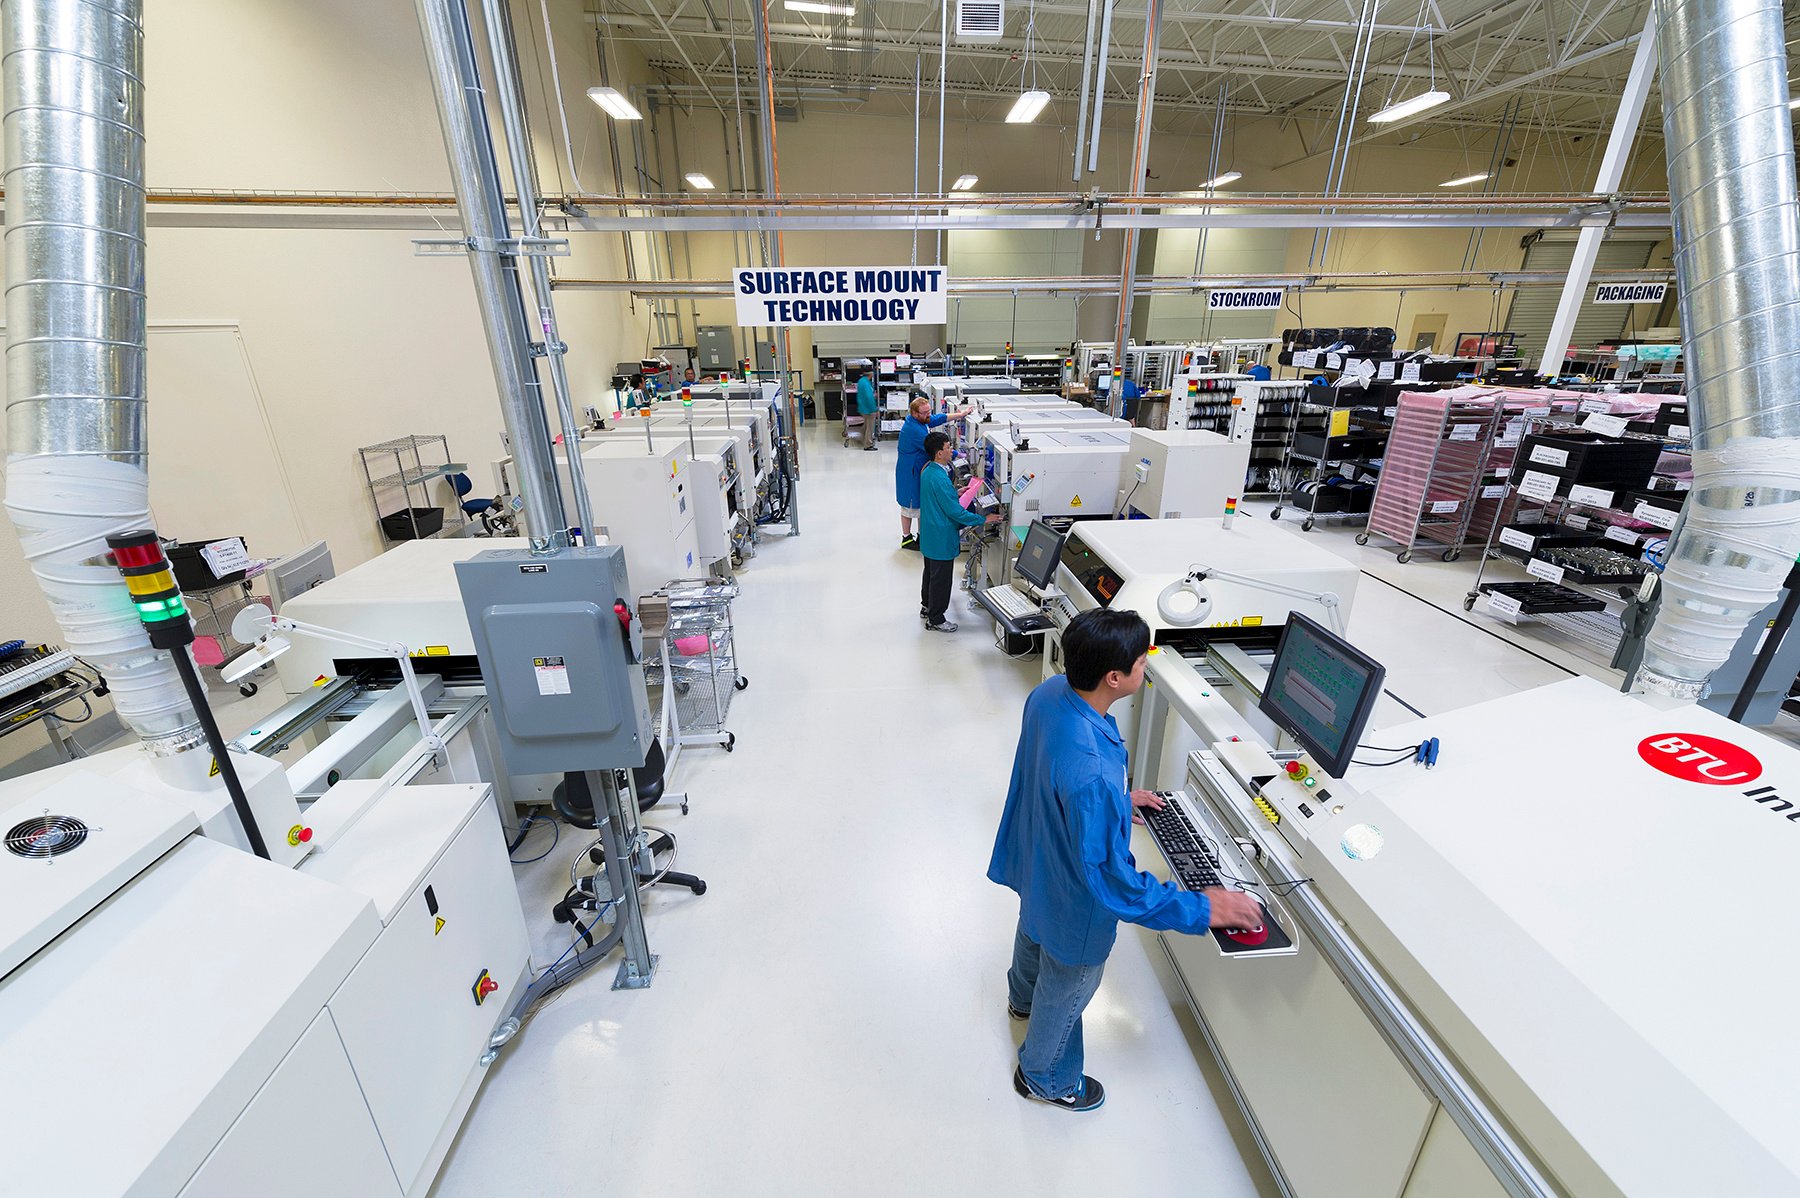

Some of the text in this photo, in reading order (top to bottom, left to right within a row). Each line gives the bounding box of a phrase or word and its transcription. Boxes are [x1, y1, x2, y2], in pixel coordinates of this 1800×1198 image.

[739, 270, 941, 294] SURFACE MOUNT
[1596, 285, 1664, 301] PACKAGING
[764, 298, 920, 322] TECHNOLOGY
[1210, 292, 1282, 307] STOCKROOM
[1648, 736, 1749, 781] BTU
